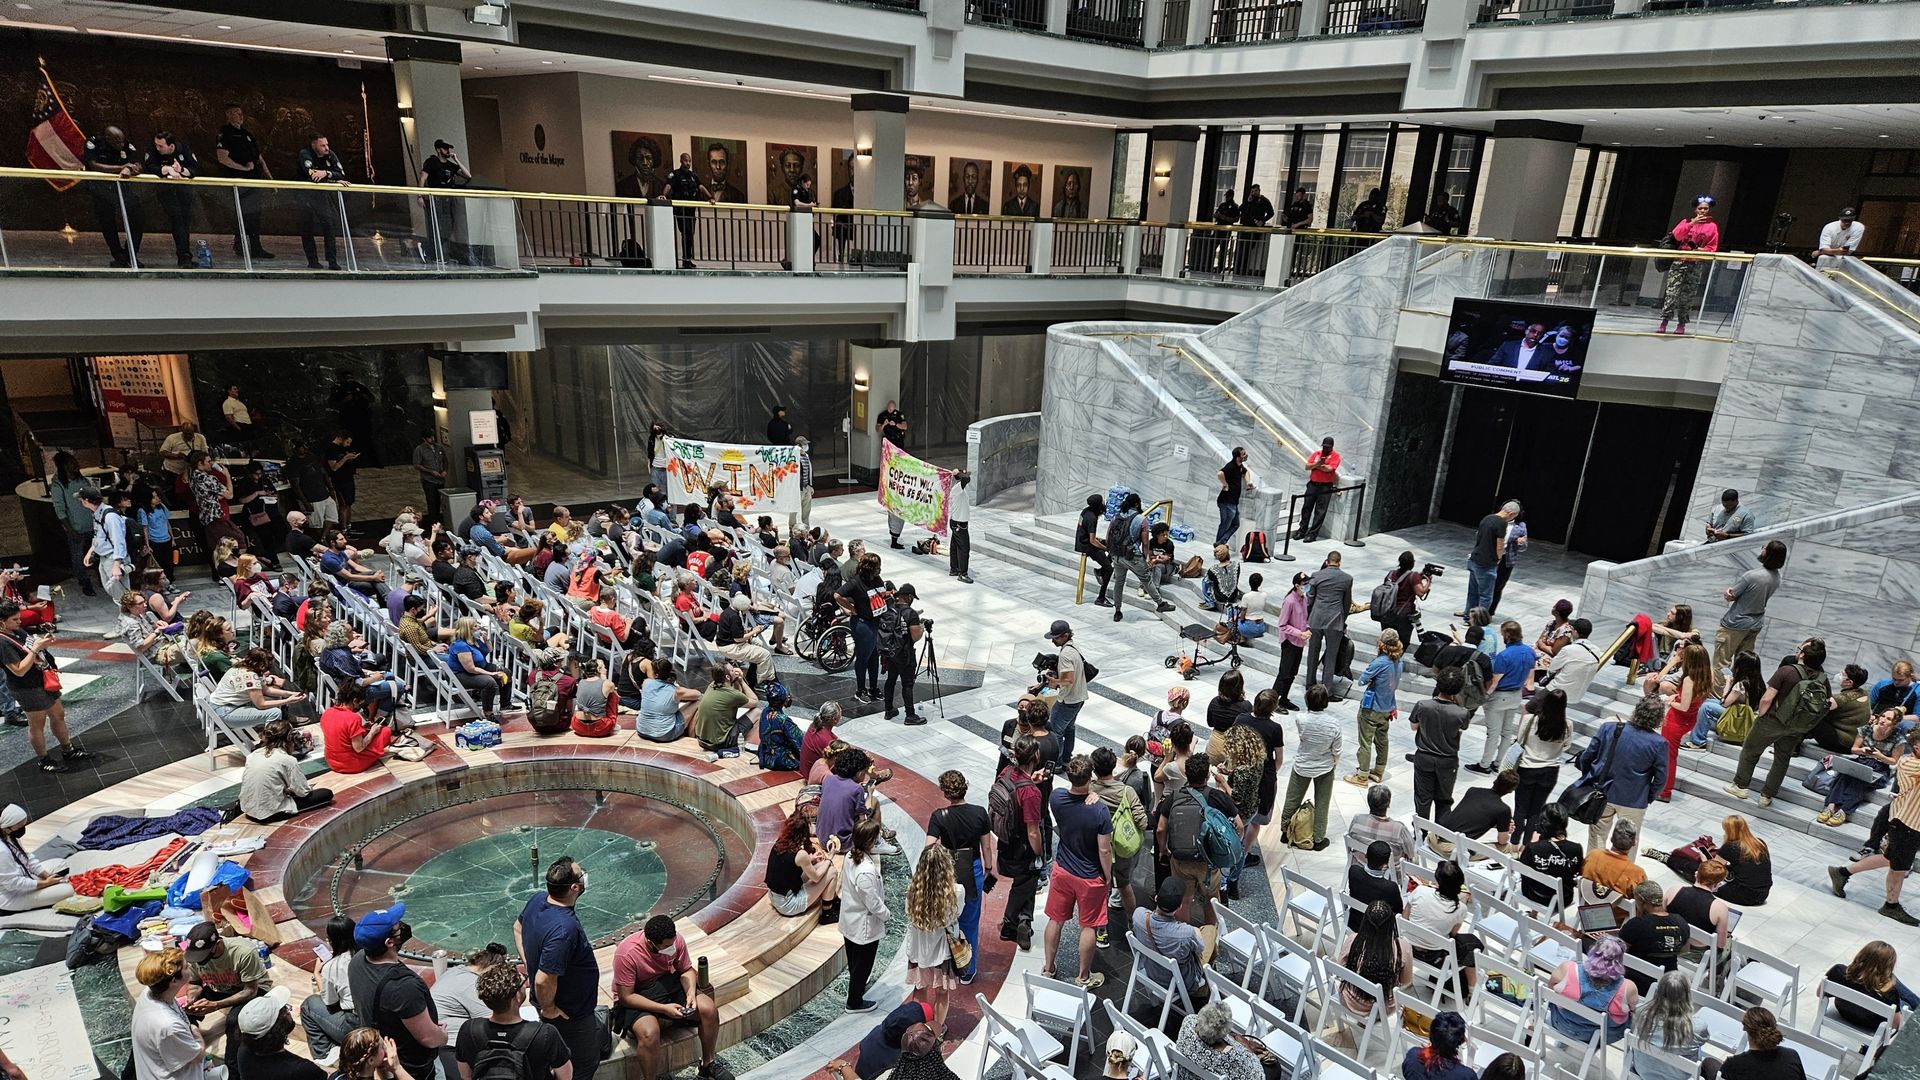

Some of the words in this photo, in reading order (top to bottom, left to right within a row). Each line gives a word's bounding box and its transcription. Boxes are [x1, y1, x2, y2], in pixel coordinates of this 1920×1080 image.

[519, 152, 534, 164] Office
[534, 152, 541, 165] of
[541, 152, 549, 165] the
[549, 153, 566, 168] Mayor
[1492, 367, 1522, 376] COMMENT
[671, 441, 705, 460] WE
[677, 458, 775, 498] WIN
[888, 480, 905, 497] NEVER
[906, 487, 915, 499] BE
[915, 490, 933, 504] BUILT
